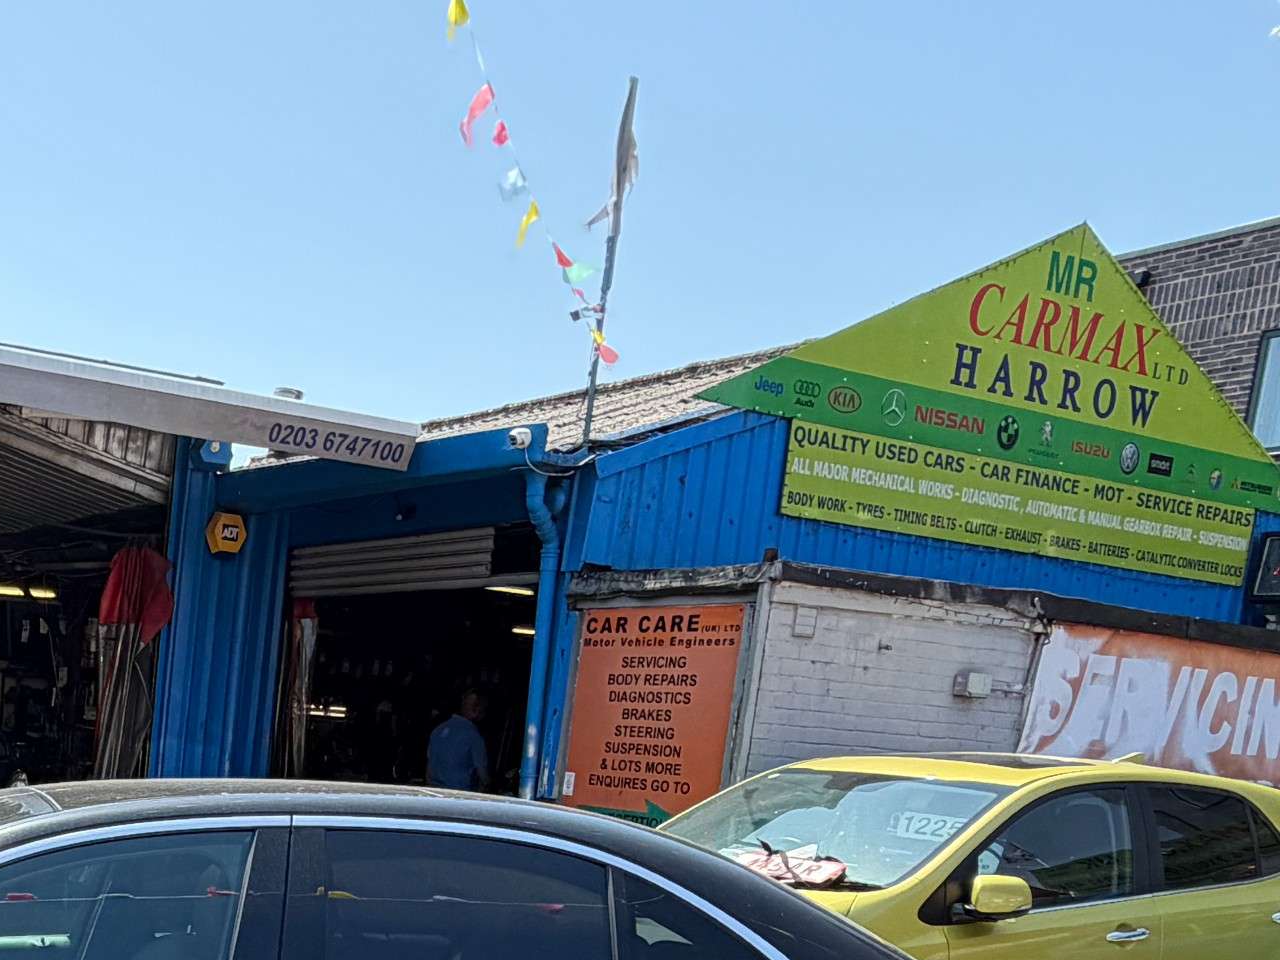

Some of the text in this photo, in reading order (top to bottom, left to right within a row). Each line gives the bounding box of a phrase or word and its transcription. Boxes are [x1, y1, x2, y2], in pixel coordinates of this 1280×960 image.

[1046, 251, 1098, 303] MR
[969, 283, 1189, 386] CARMAX LTD
[754, 375, 785, 397] Jeep
[951, 342, 1160, 429] HARROW
[793, 397, 815, 409] Audi
[832, 391, 857, 409] KIA
[914, 405, 985, 435] NISSAN
[268, 423, 405, 464] 0203 6747100
[793, 426, 871, 455] QUALITY
[875, 441, 918, 464] USED
[923, 451, 966, 473] CARS
[980, 462, 1010, 482] CAR
[1015, 469, 1080, 495] FINANCE
[1093, 484, 1125, 503] MOT
[1136, 492, 1193, 519] SERVICE
[1196, 504, 1252, 528] REPAIRS
[791, 457, 811, 475] ALL
[813, 460, 849, 482] MAJOR
[851, 467, 915, 493] MECHANICAL
[918, 479, 954, 499] WORKS
[1025, 500, 1078, 522] AUTOMATIC
[1087, 510, 1121, 530] MANUAL
[1123, 517, 1161, 537] GEARBOX
[1161, 526, 1193, 542] REPAIR
[221, 527, 239, 540] ADT
[787, 491, 815, 508] BODY
[817, 496, 847, 513] WORK
[856, 502, 885, 519] TYRES
[894, 508, 928, 527] TIMING
[930, 515, 958, 531] BELTS
[964, 520, 998, 537] CLUTCH
[1004, 527, 1043, 545] EXHAUST
[1049, 534, 1081, 551] BRAKES
[1087, 542, 1130, 559] BATTERIES
[1135, 550, 1177, 568] CATALYTIC
[1177, 556, 1220, 575] CONVERTER
[1220, 563, 1244, 578] LOCKS
[586, 616, 628, 634] CAR
[638, 614, 701, 633] CARE
[723, 624, 742, 633] LTD
[583, 636, 735, 649] Motor Vehicle Engineers
[621, 656, 687, 669] SERVICING
[608, 673, 697, 687] BODY REPAIRS
[608, 690, 691, 705] DIAGNOSTICS
[622, 708, 672, 722] BRAKES
[614, 725, 675, 740] STEERING
[604, 742, 682, 758] SUSPENSION
[600, 758, 682, 776] & LOTS MORE
[588, 774, 647, 791] ENQUIRES
[650, 780, 670, 793] GO
[673, 782, 690, 795] TO
